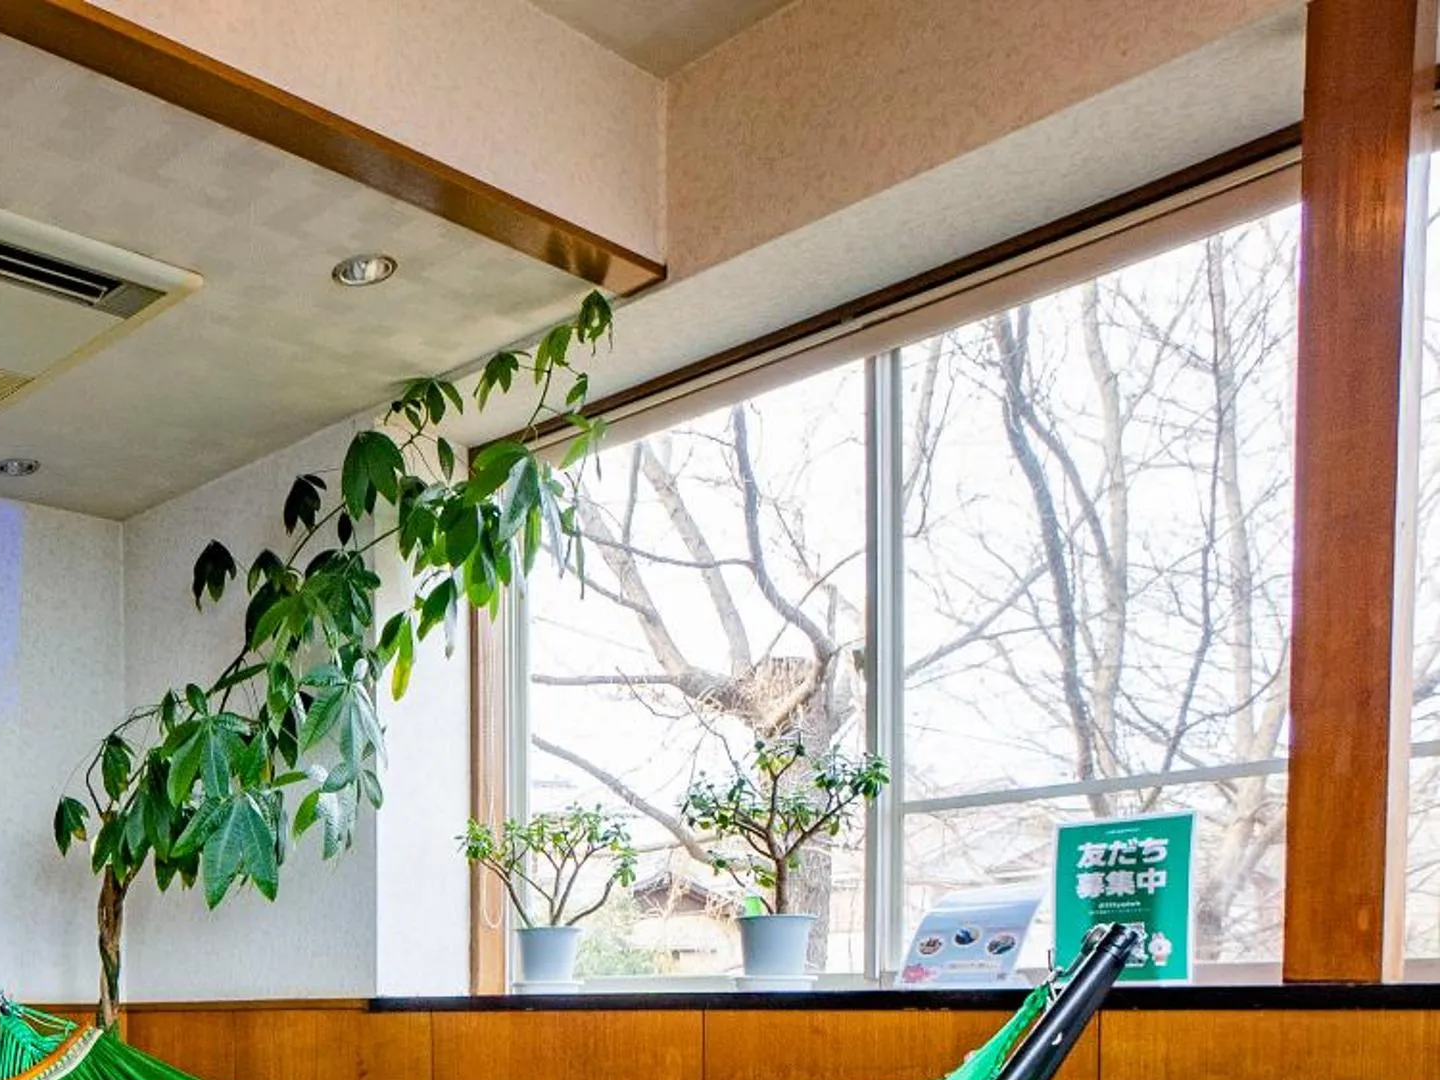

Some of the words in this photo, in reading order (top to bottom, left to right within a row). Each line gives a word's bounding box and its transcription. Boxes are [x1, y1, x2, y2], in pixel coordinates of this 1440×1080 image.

[1076, 837, 1169, 868] 友だち
[1076, 867, 1167, 899] 募集中
